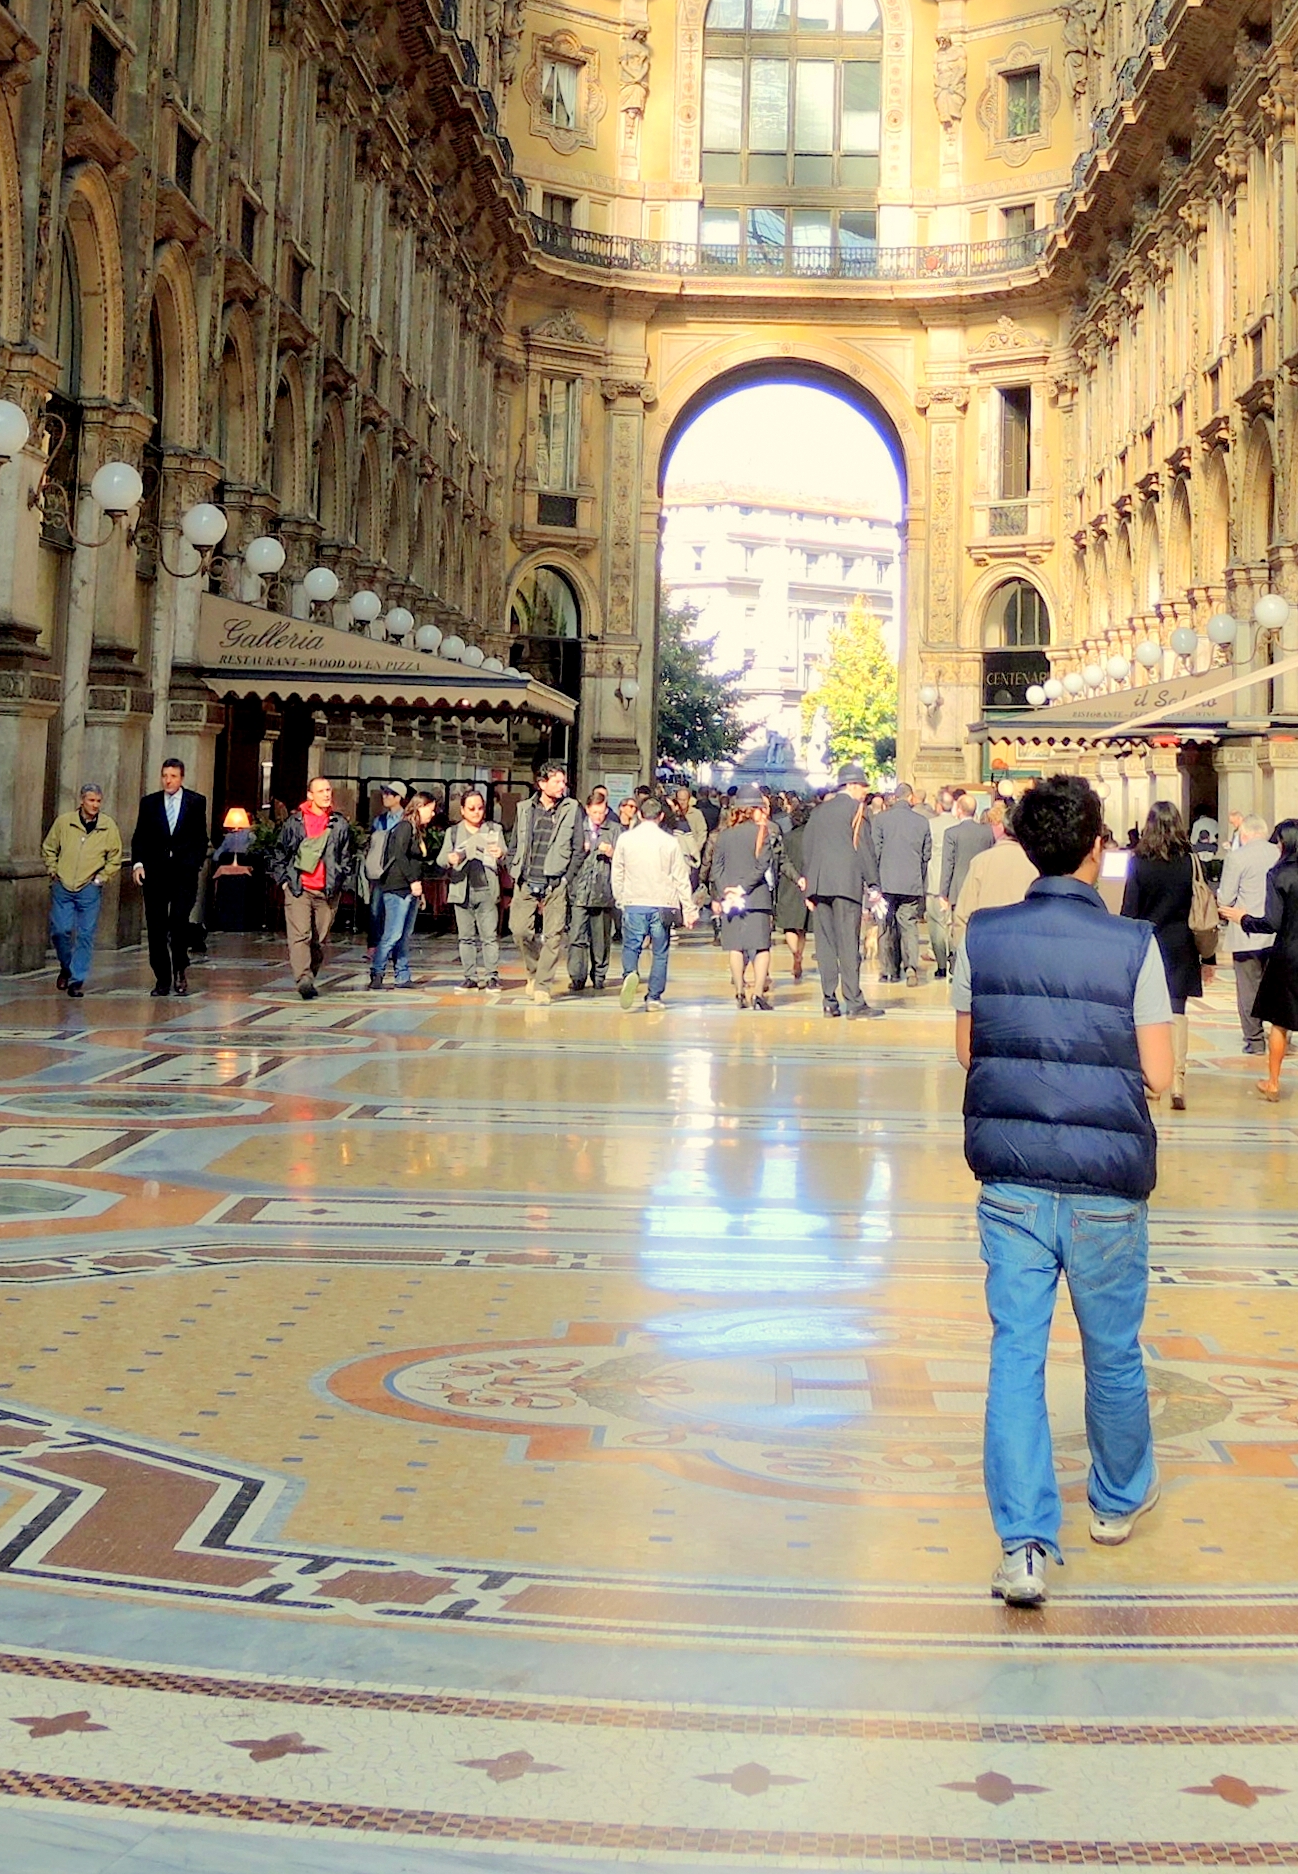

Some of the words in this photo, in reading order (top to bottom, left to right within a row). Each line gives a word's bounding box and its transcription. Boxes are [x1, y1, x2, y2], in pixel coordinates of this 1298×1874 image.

[219, 618, 325, 650] Galleria
[218, 654, 299, 667] RESTAURANT
[308, 658, 345, 669] WOOD
[348, 659, 381, 670] OVEN
[385, 660, 423, 672] PIZZA
